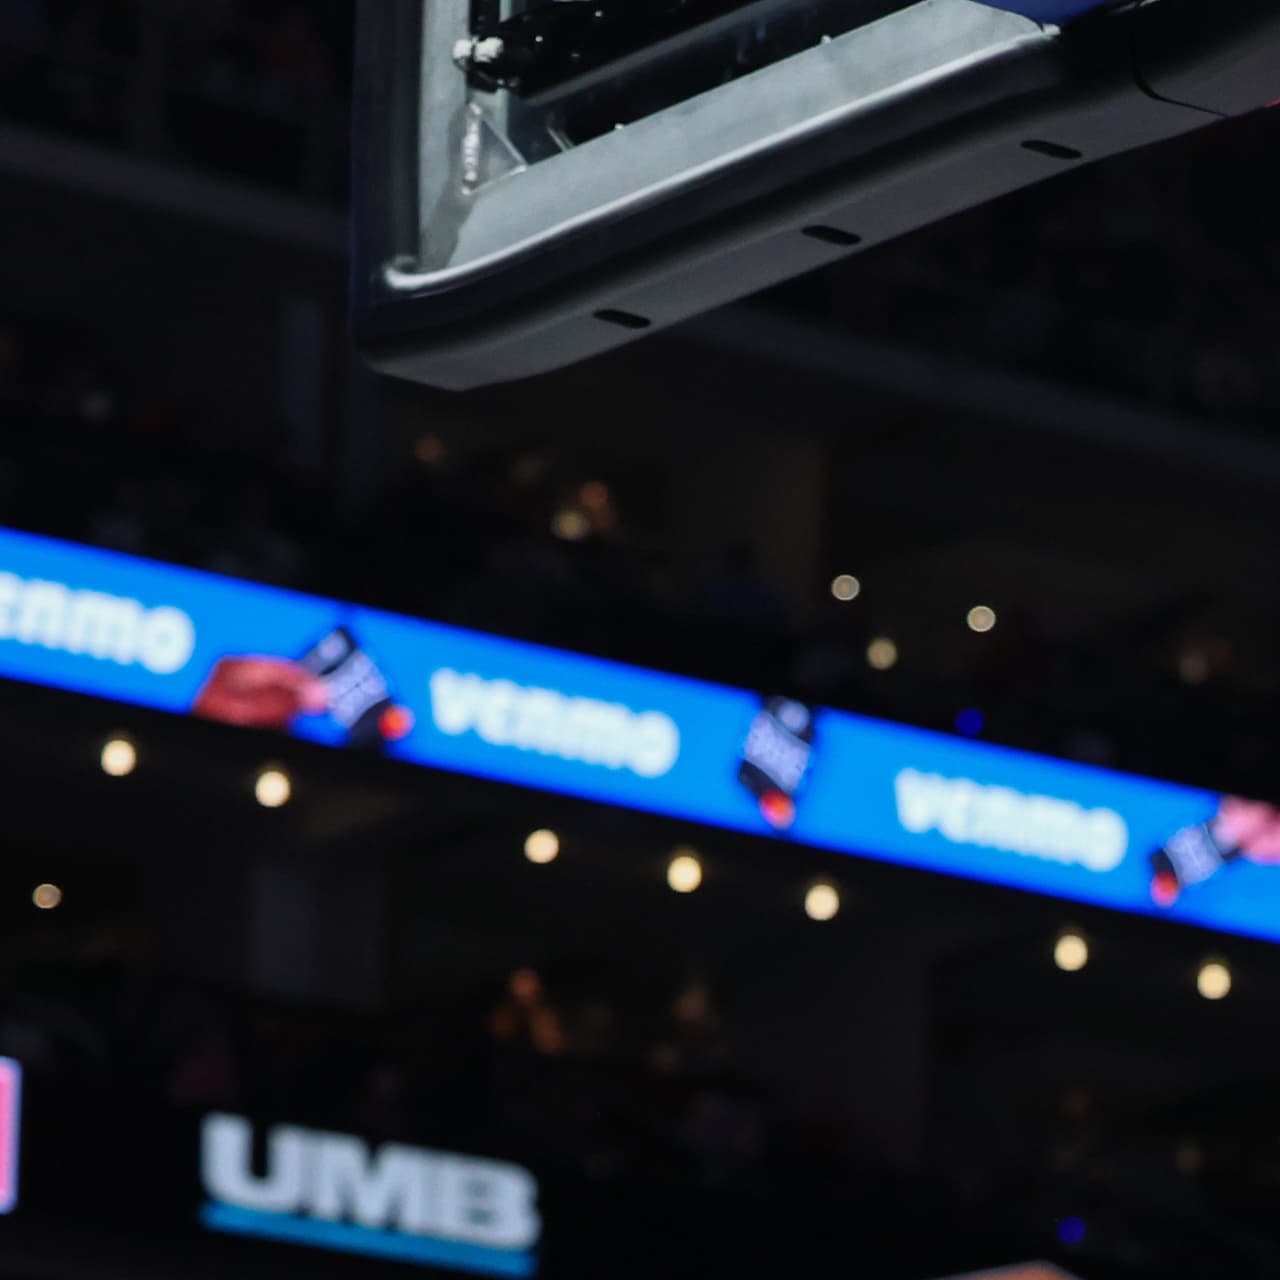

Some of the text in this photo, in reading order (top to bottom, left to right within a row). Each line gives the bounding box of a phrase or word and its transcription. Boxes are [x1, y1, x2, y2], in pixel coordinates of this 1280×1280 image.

[0, 570, 196, 676] enmo
[430, 667, 680, 778] venmo
[895, 767, 1129, 873] venmo
[202, 1112, 541, 1250] UMB
